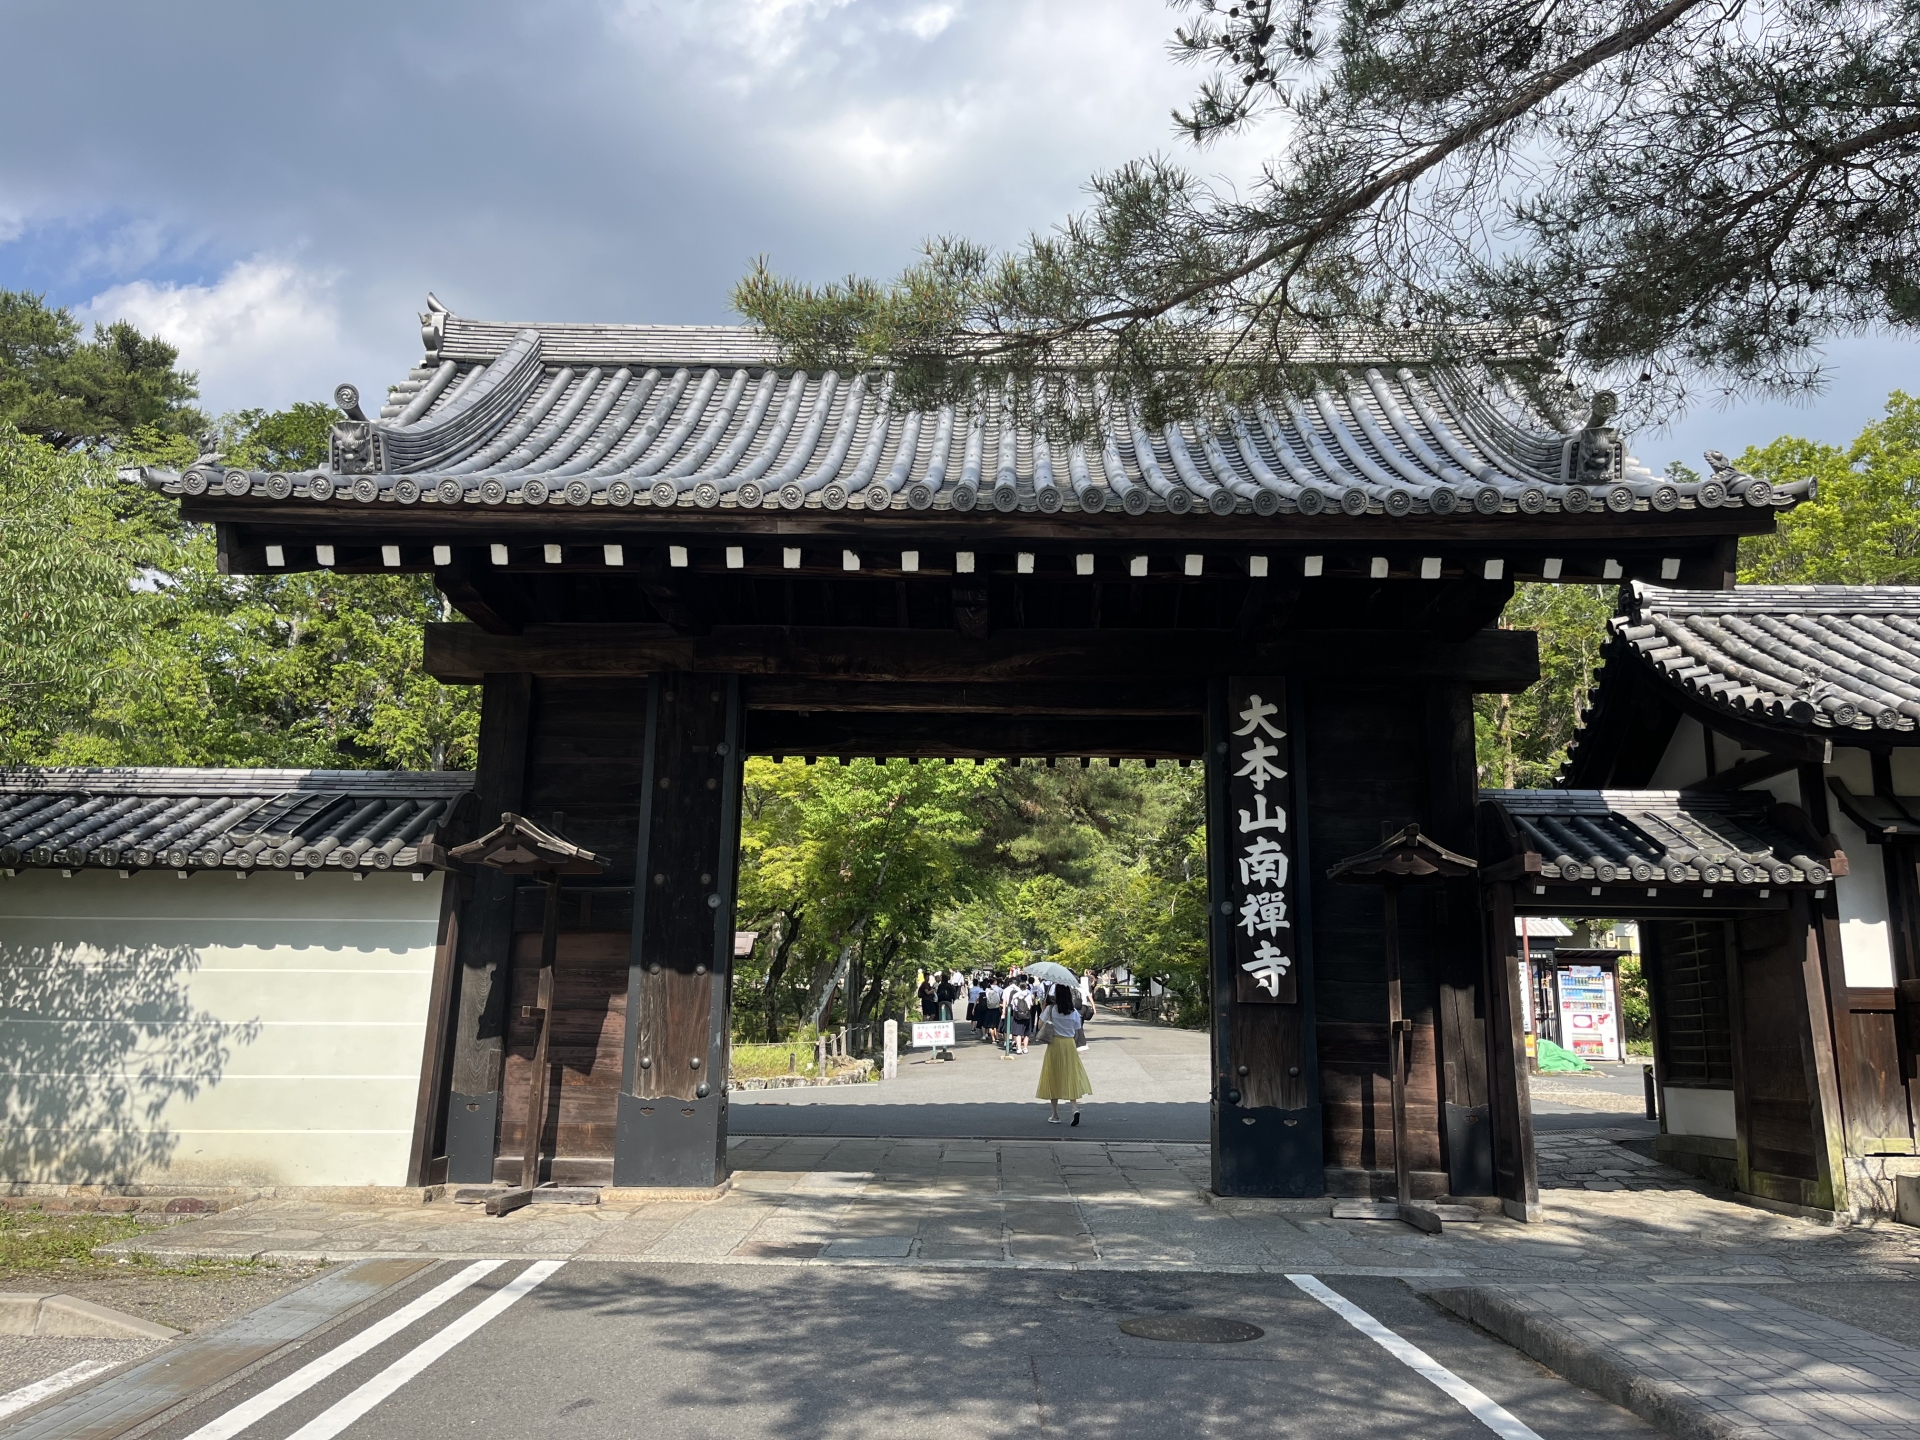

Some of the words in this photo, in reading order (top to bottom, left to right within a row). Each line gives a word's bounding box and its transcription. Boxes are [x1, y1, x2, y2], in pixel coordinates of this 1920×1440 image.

[1232, 694, 1291, 998] 大本山南禪寺
[916, 1031, 950, 1039] 進入禁止
